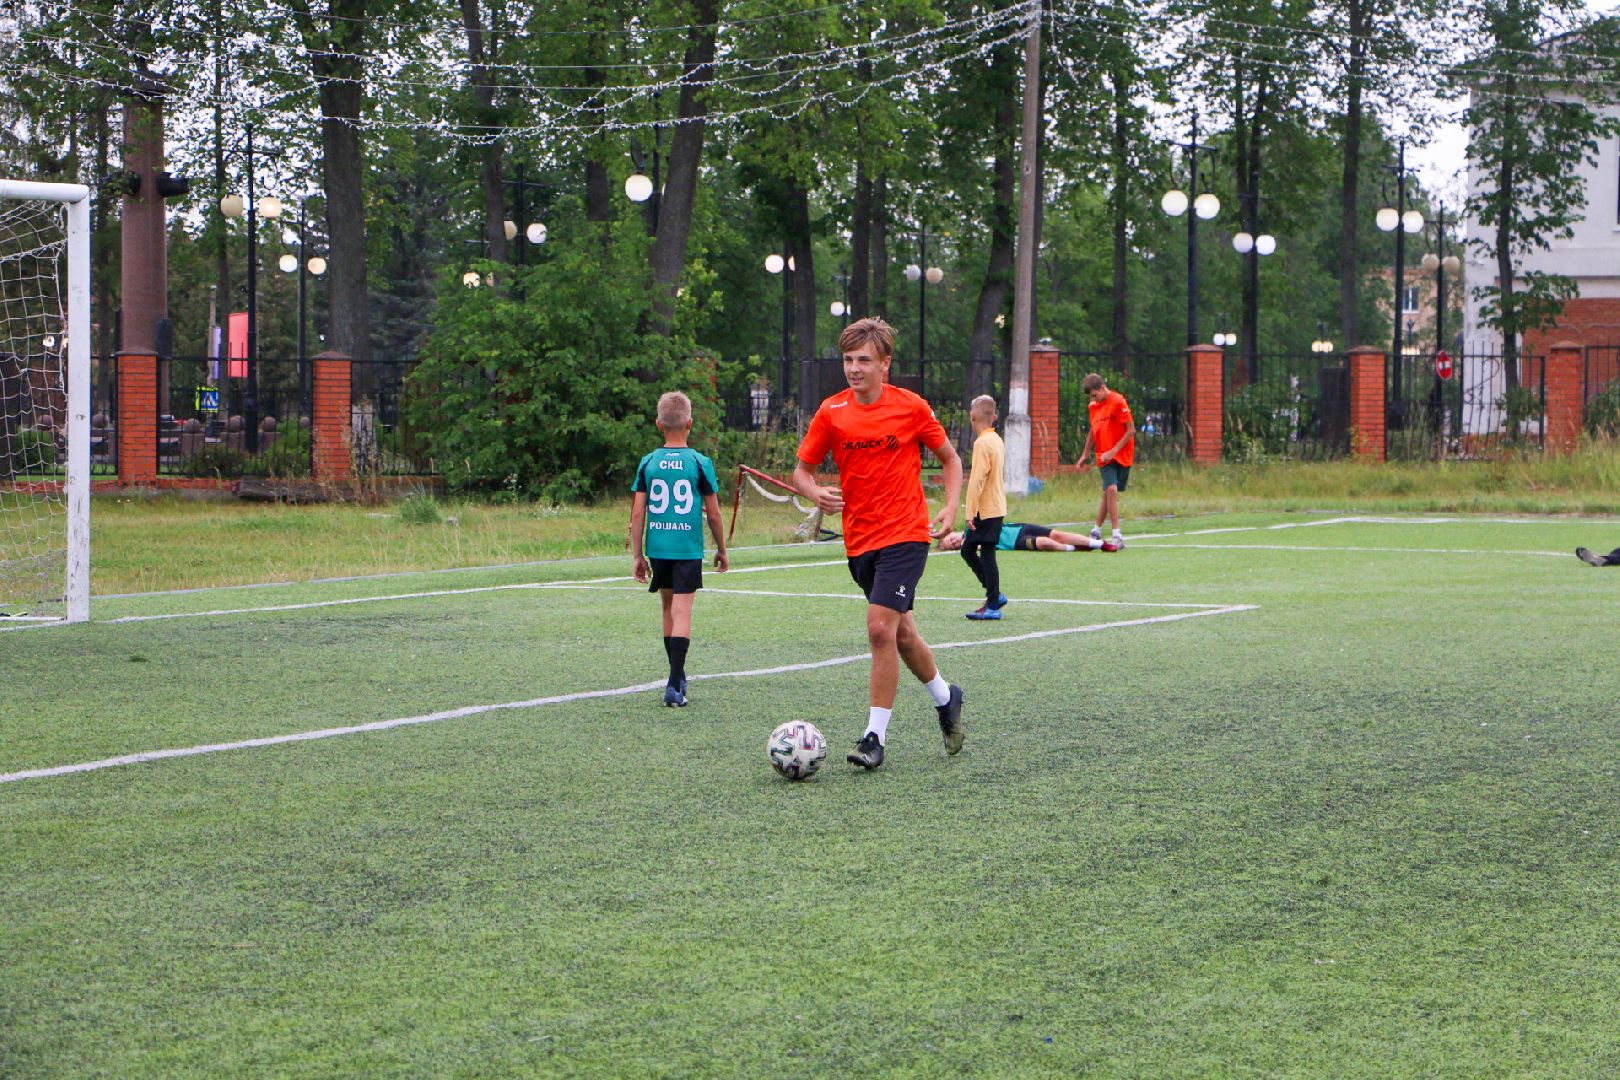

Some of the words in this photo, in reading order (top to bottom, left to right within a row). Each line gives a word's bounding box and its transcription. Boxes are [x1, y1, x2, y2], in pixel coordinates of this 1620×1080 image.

[659, 460, 683, 470] СКЦ
[648, 478, 694, 515] 99
[649, 521, 692, 531] РОШАЛЬ
